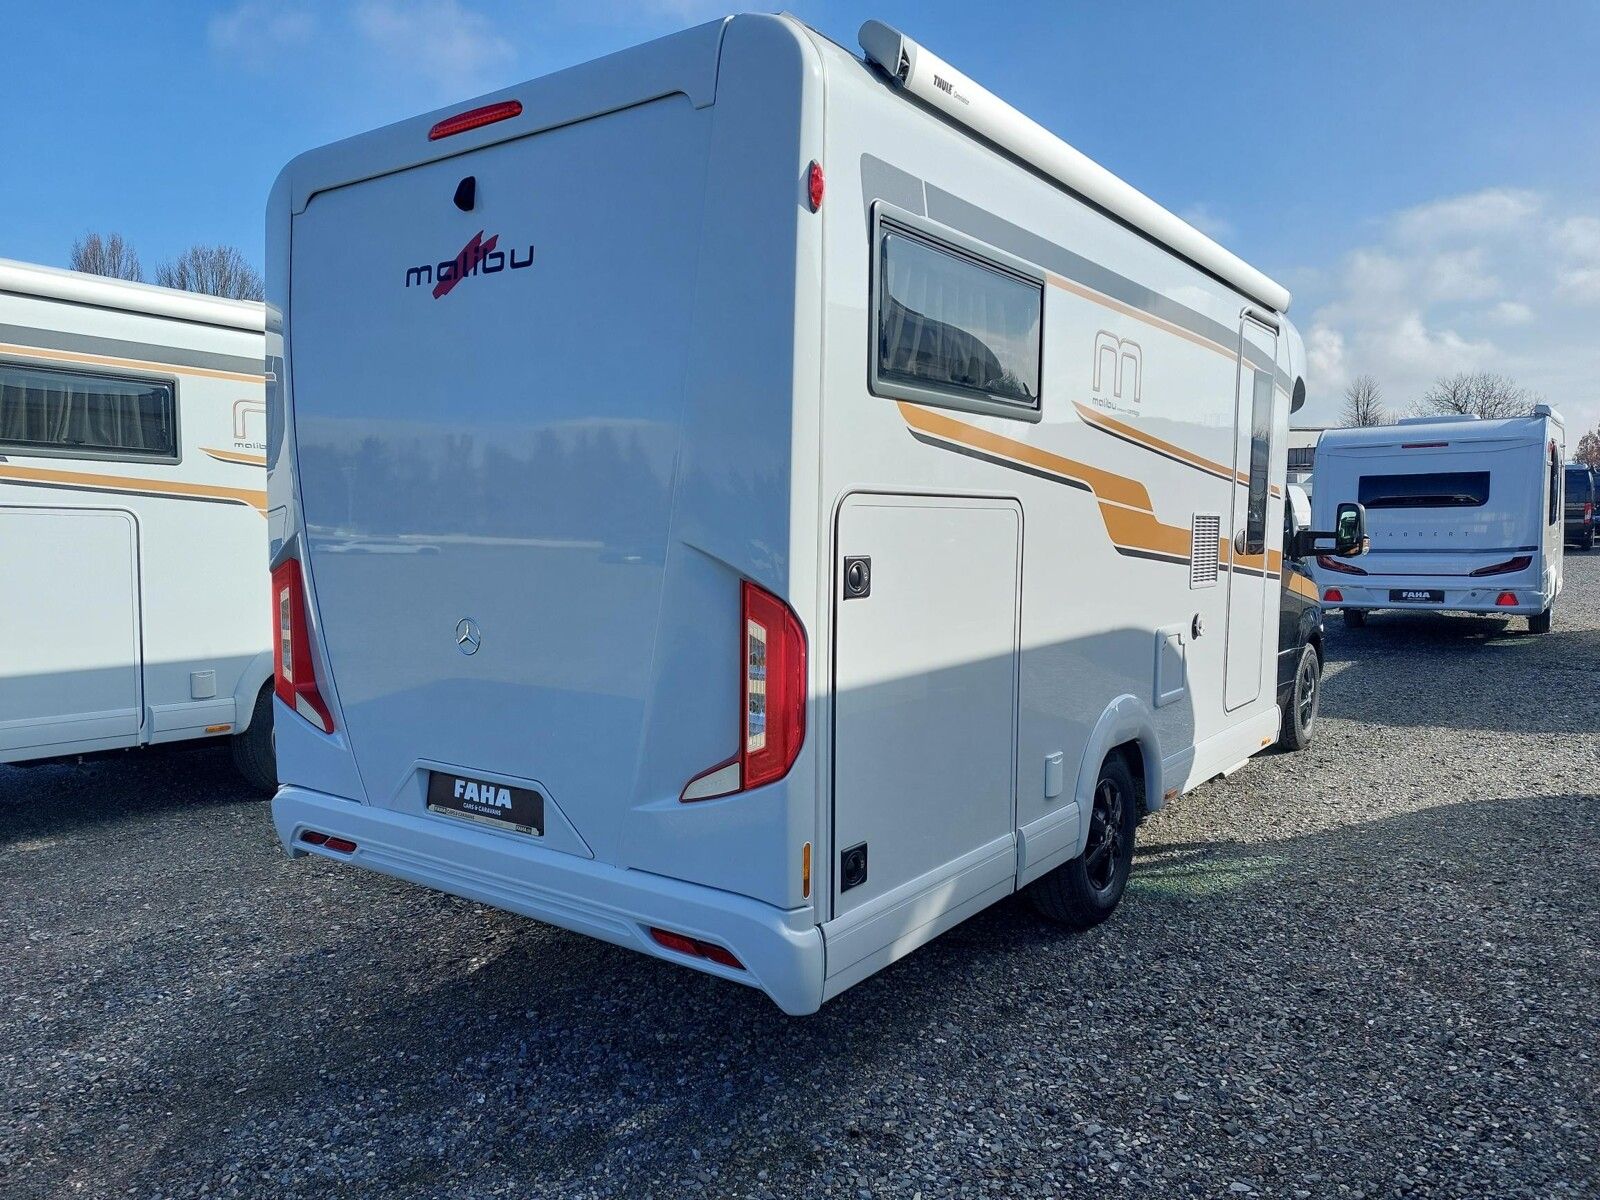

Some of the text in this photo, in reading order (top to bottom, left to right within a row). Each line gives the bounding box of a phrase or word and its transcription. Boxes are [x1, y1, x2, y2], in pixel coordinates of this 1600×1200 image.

[933, 74, 953, 95] THULE
[405, 245, 535, 288] malibu
[1092, 397, 1117, 410] malibu
[454, 779, 512, 809] FAHA
[463, 802, 474, 810] CARS
[478, 806, 502, 816] CARAVANS
